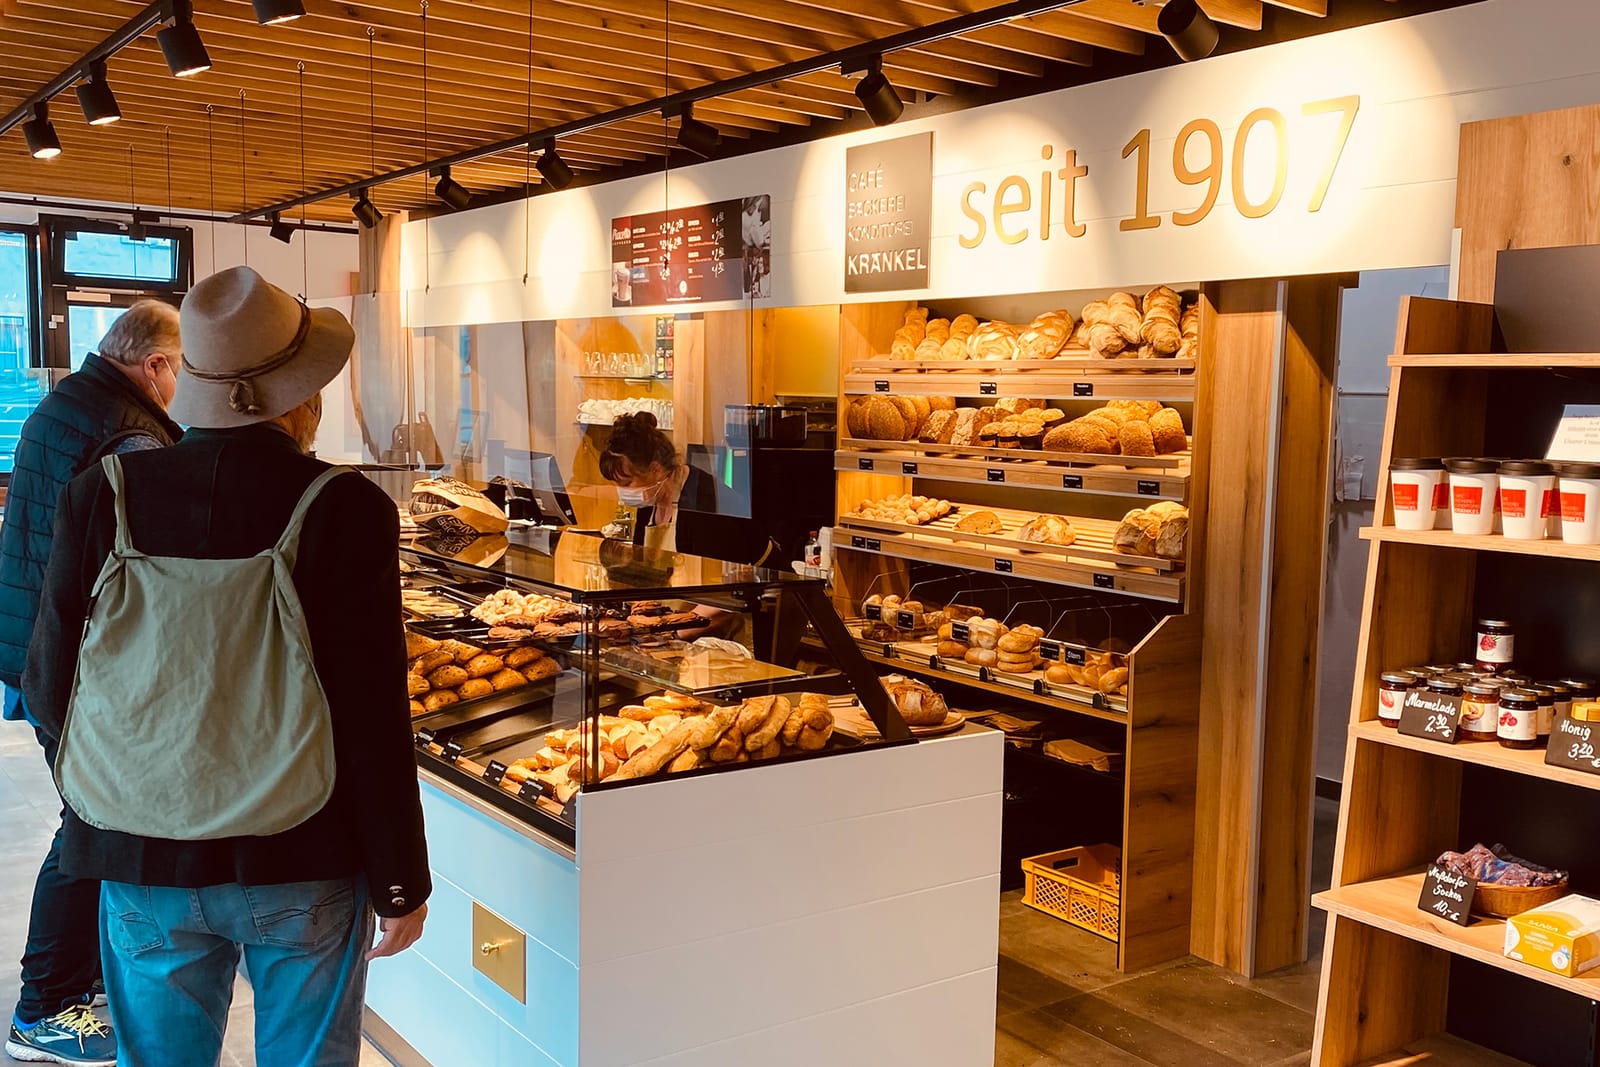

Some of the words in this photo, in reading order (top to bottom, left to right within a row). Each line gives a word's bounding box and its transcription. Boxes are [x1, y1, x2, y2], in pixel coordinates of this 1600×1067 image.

[848, 163, 884, 193] CAFÉ
[958, 145, 1088, 250] seit
[1119, 94, 1361, 233] 1907
[848, 246, 928, 276] KRÄNKEL
[1405, 692, 1456, 716] Marmelade
[1560, 719, 1592, 742] Honig
[1431, 883, 1464, 903] Socken
